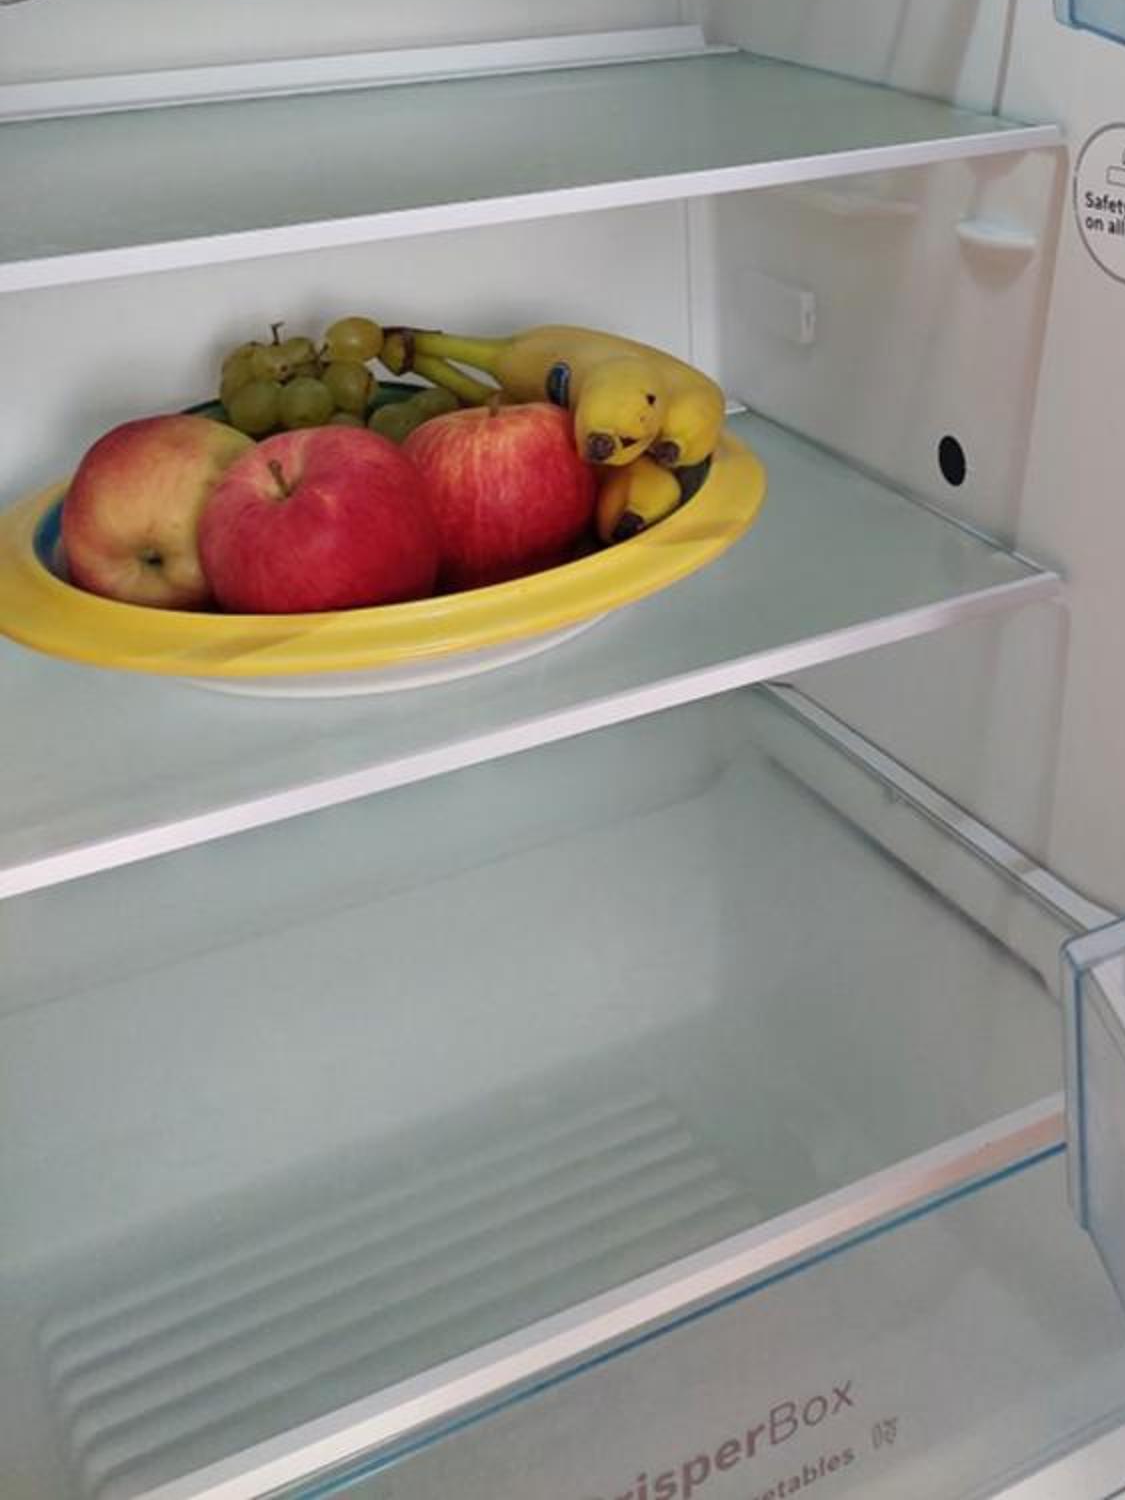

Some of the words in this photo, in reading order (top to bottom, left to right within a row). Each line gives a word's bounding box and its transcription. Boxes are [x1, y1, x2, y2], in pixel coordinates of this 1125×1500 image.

[1085, 216, 1104, 231] on
[1108, 218, 1125, 236] all
[582, 1379, 854, 1500] isperBox
